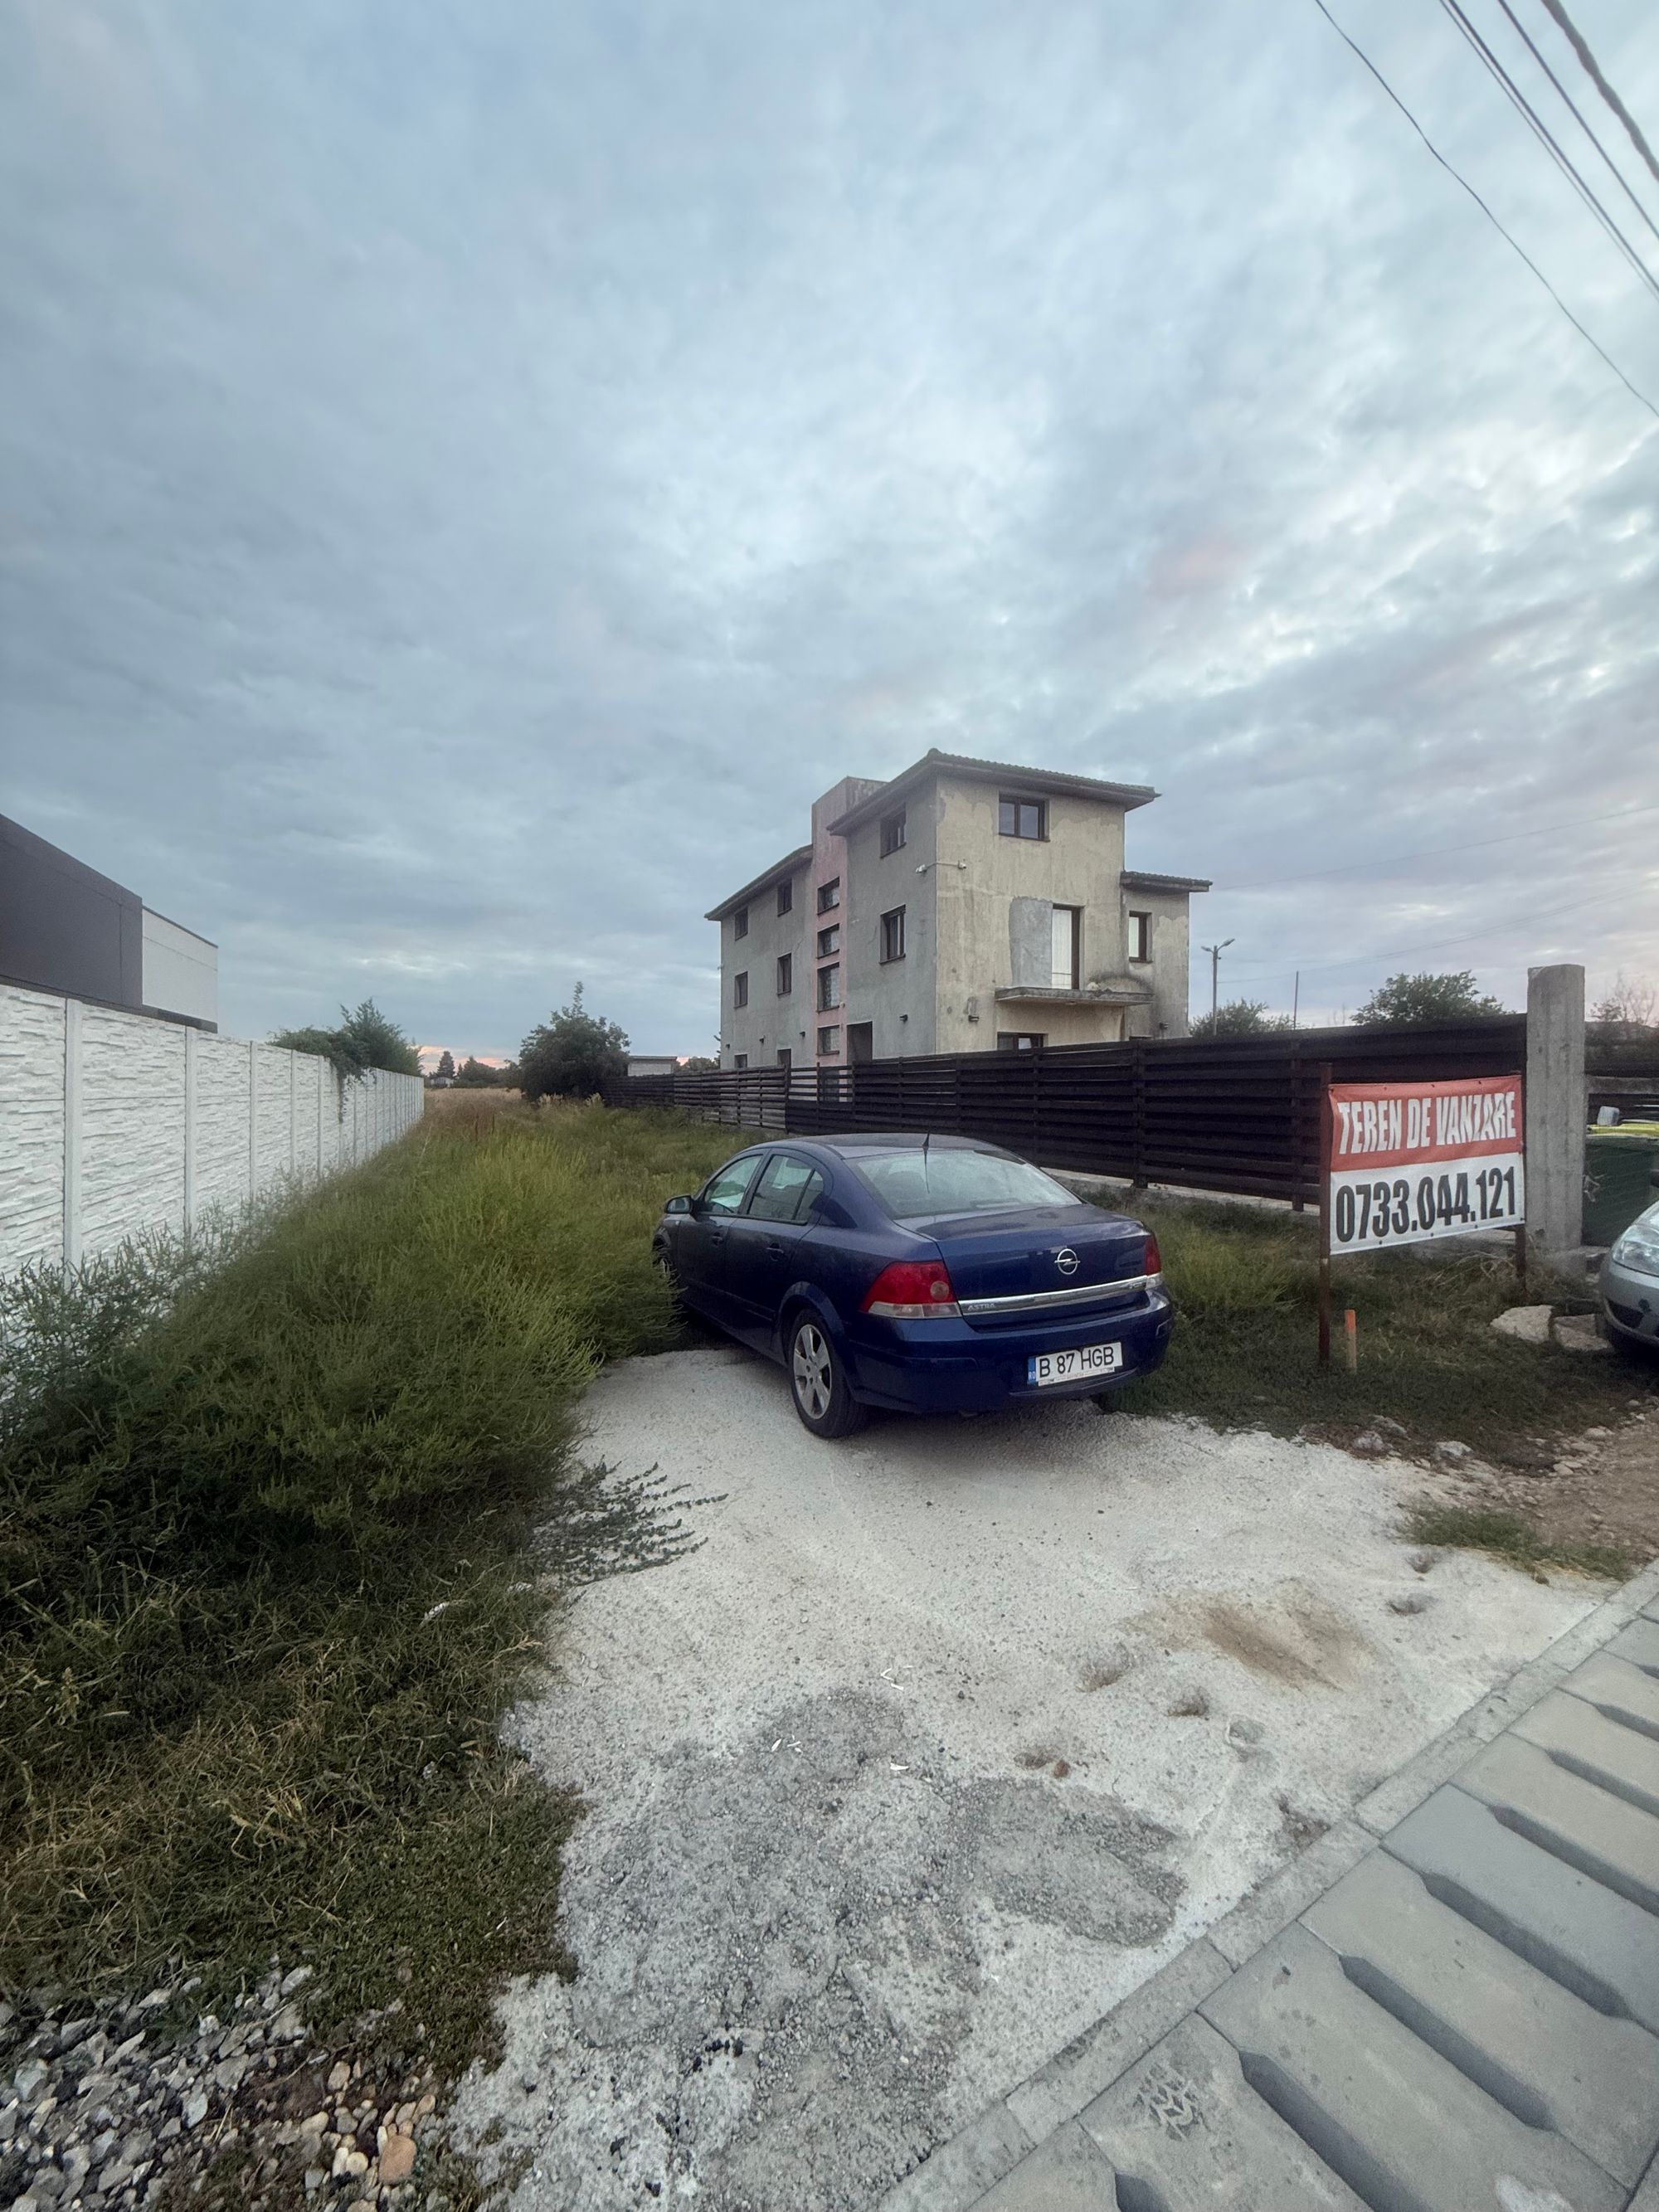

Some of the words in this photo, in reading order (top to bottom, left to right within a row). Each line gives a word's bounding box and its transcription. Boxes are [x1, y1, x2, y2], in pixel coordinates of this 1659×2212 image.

[1336, 1099, 1403, 1155] TEREN
[1406, 1097, 1432, 1150] DE
[1436, 1091, 1517, 1146] VANZARE
[1335, 1166, 1515, 1243] 0733.044.121
[1039, 1358, 1050, 1378] B
[1056, 1353, 1075, 1374] 87
[1080, 1346, 1114, 1370] HGB
